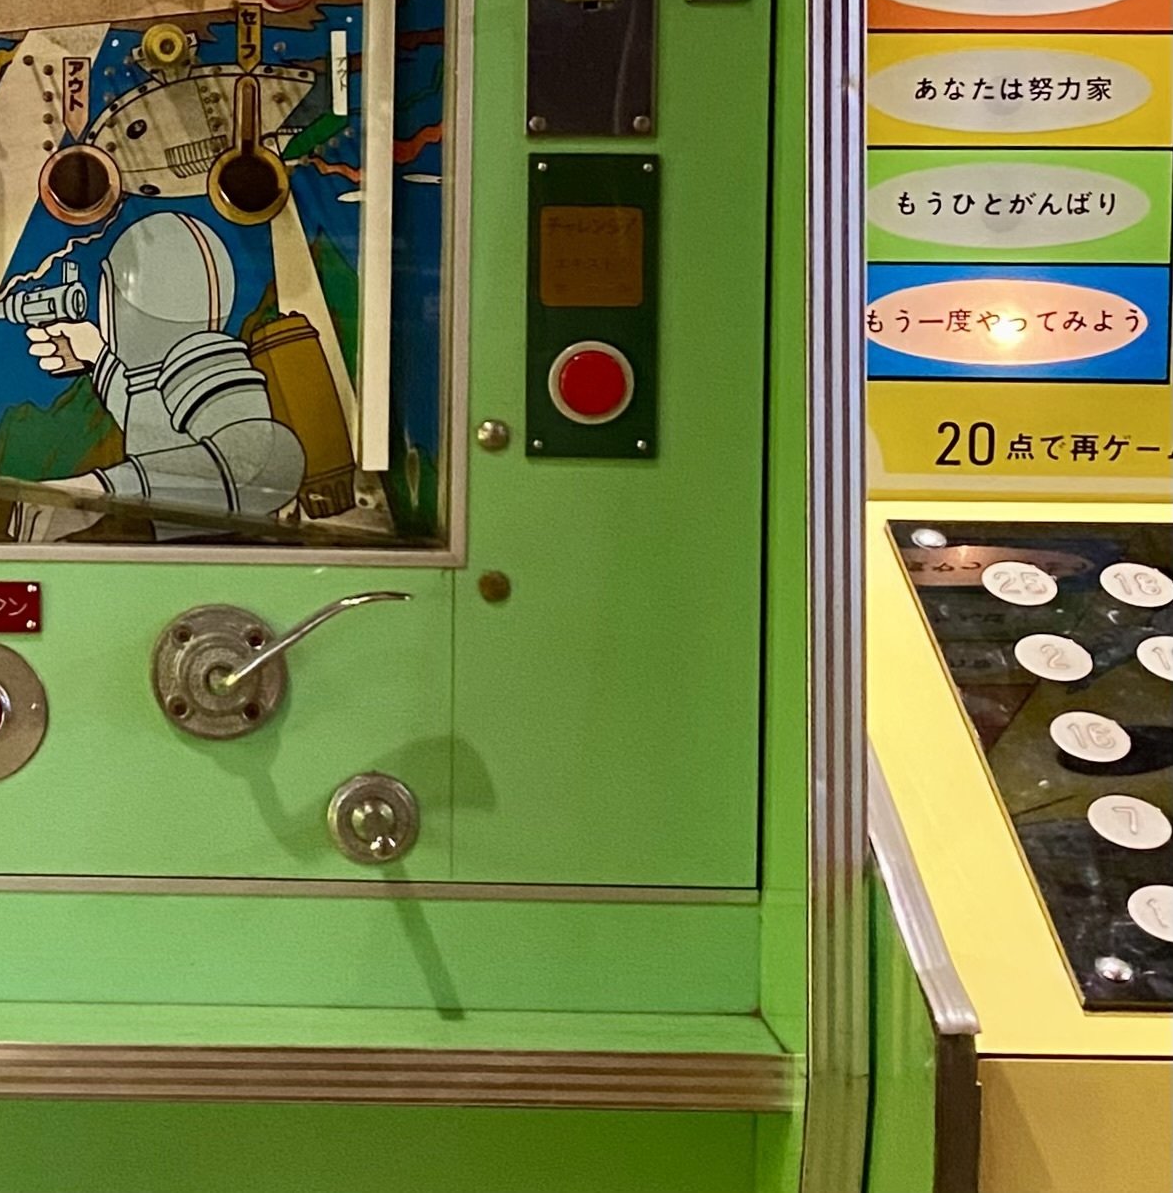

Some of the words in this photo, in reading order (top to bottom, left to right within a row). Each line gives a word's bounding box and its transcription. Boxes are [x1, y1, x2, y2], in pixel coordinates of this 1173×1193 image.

[240, 10, 259, 58] セーフ
[67, 61, 85, 111] アウト
[914, 76, 1112, 102] あなたは努力家
[897, 191, 1117, 216] もうひとがんばり
[866, 308, 1141, 334] もう一度やってみよう
[935, 421, 1173, 466] 20点で再ゲー
[1040, 644, 1070, 669] 2
[1112, 806, 1138, 835] 7
